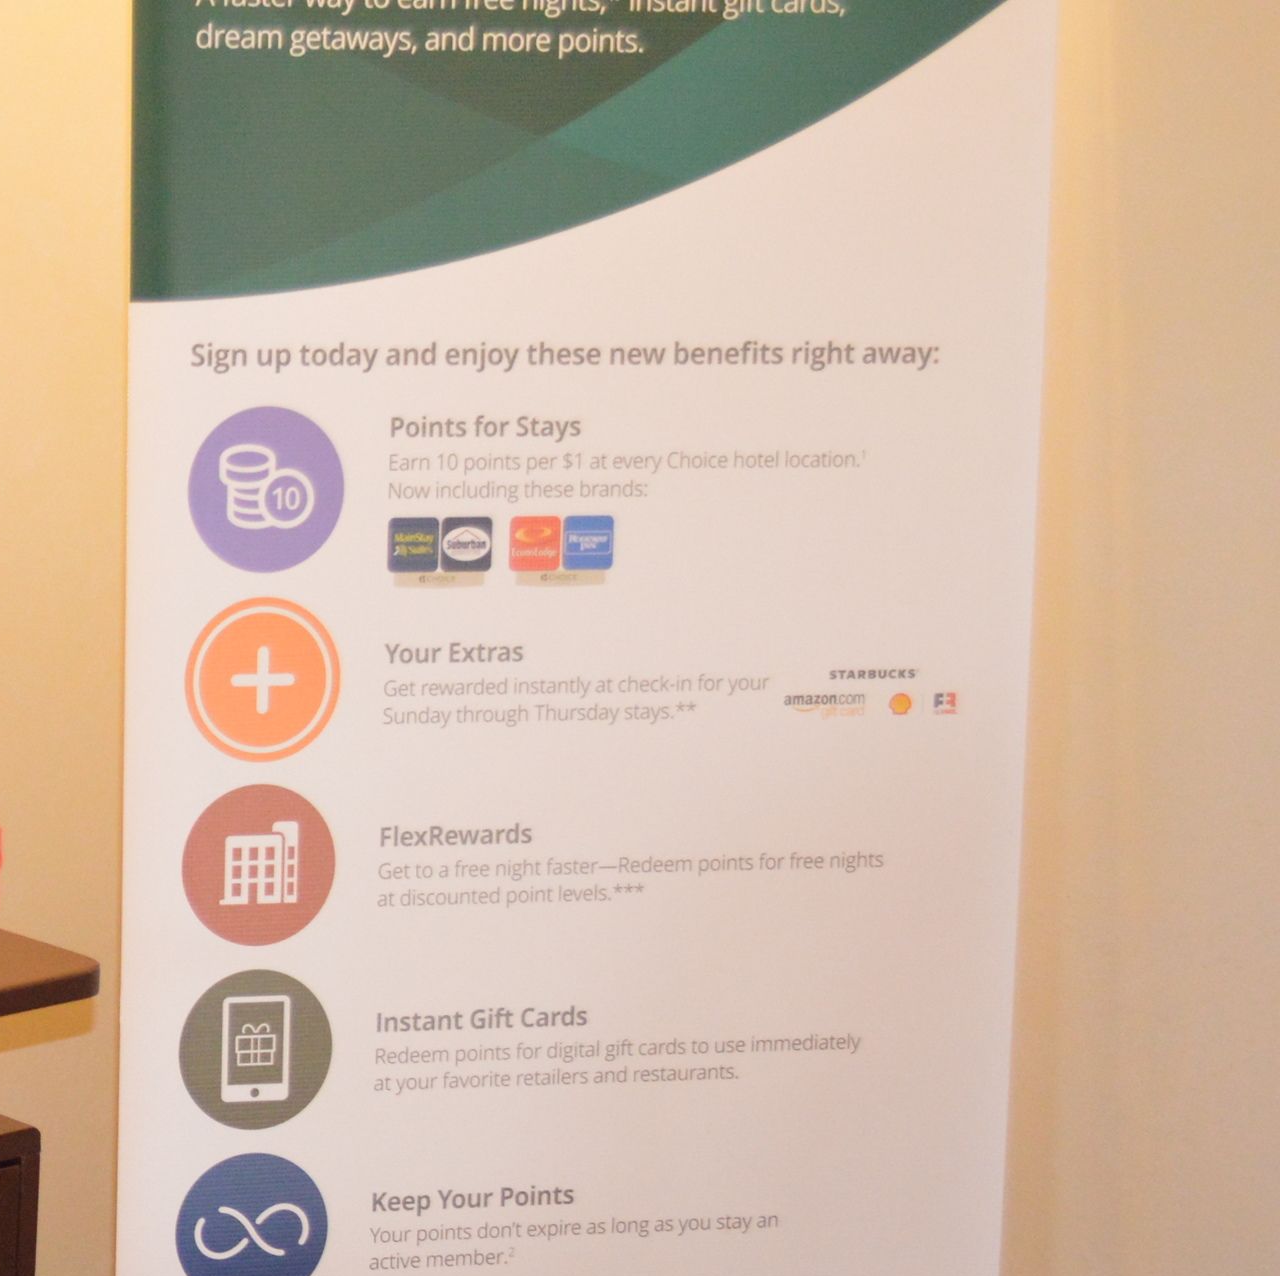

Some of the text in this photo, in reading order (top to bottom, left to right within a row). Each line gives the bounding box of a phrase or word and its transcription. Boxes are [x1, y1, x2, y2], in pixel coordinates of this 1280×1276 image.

[195, 22, 645, 62] dream getaways, and more points.
[190, 340, 940, 376] Sign up today and enjoy these new benefits right away:
[390, 415, 582, 445] Points for Stays
[388, 450, 780, 478] Earn 10 points per $1 at every Choice hotel
[272, 486, 300, 511] 10
[387, 480, 649, 506] Now including these brands:
[384, 642, 524, 666] Your Extras
[383, 672, 771, 701] Get rewarded instantly at check-in for your
[783, 692, 866, 707] amazon.com
[382, 706, 453, 730] Sunday
[455, 704, 529, 730] through
[533, 703, 621, 728] Thursday
[379, 822, 533, 849] FlexRewards
[377, 862, 411, 882] Get
[415, 864, 434, 882] to
[438, 864, 450, 880] a
[454, 859, 491, 880] free
[495, 859, 542, 884] night
[697, 854, 755, 879] points
[758, 852, 785, 873] for
[789, 851, 825, 872] free
[829, 851, 885, 876] nights
[376, 891, 396, 909] at
[399, 886, 501, 909] discounted
[505, 886, 554, 911] point
[376, 1005, 588, 1034] Instant Gift Cards
[375, 1033, 862, 1069] Redeem points for digital gift cards to use immediately
[373, 1065, 739, 1098] at your favorite retailers and restaurants.
[371, 1185, 575, 1219] Keep Your Points
[369, 1227, 412, 1246] Your
[416, 1223, 473, 1248] points
[526, 1220, 582, 1243] expire
[585, 1221, 607, 1237] as
[611, 1216, 650, 1240] long
[653, 1219, 675, 1235] as
[677, 1218, 712, 1238] you
[716, 1215, 753, 1237] stay
[756, 1215, 779, 1231] an
[368, 1253, 422, 1272] active
